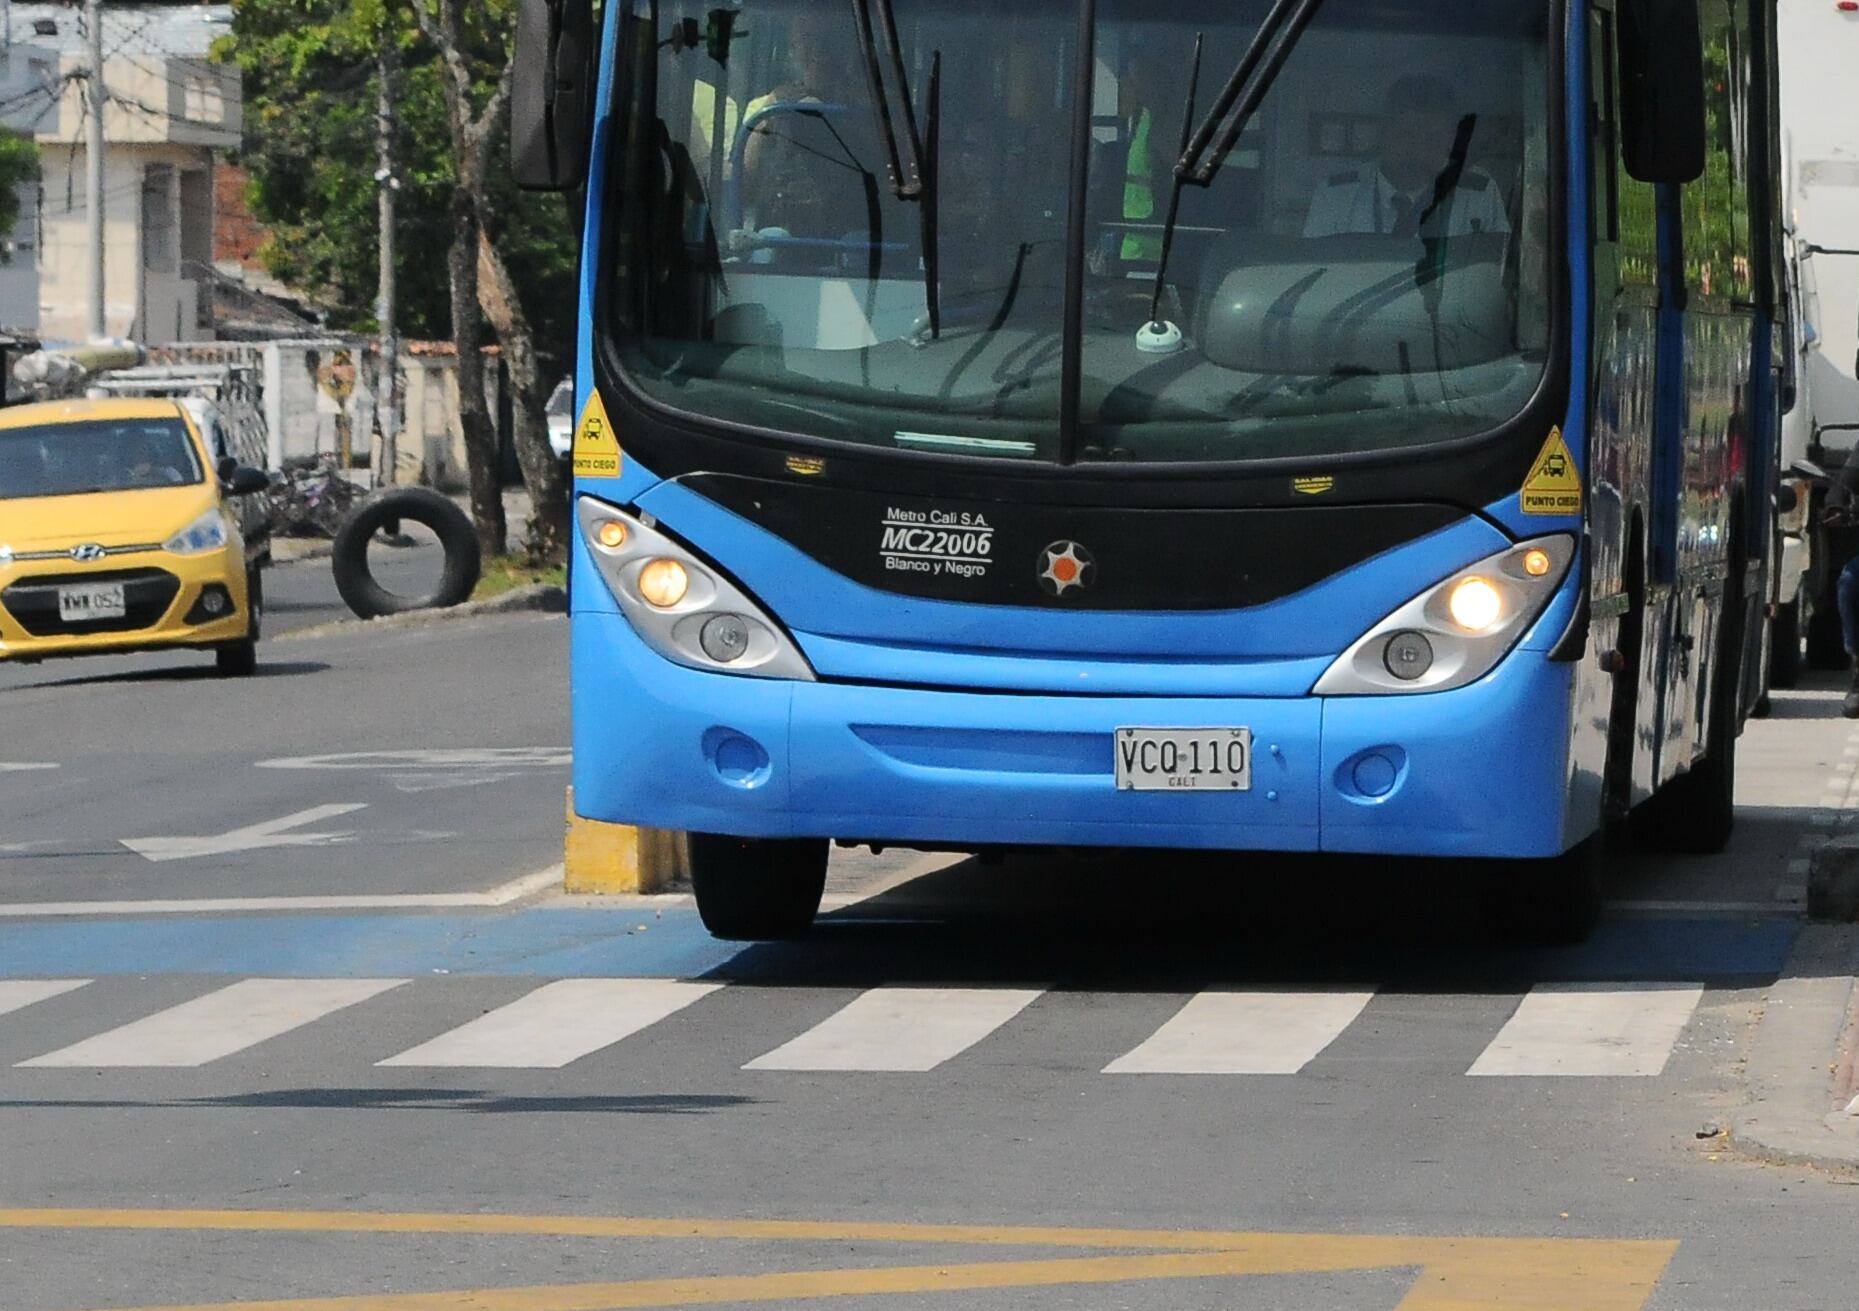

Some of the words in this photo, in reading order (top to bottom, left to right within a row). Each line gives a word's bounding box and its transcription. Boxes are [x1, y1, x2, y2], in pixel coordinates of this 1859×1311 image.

[592, 459, 616, 470] CIEGO
[1525, 495, 1555, 506] PUNTO
[887, 506, 926, 522] Metro
[930, 510, 958, 524] Cali
[960, 512, 989, 527] S.A.
[881, 527, 993, 555] MC22006
[885, 556, 931, 572] Blanco
[933, 562, 942, 576] y
[945, 561, 986, 578] Negro
[1168, 776, 1197, 787] CALI
